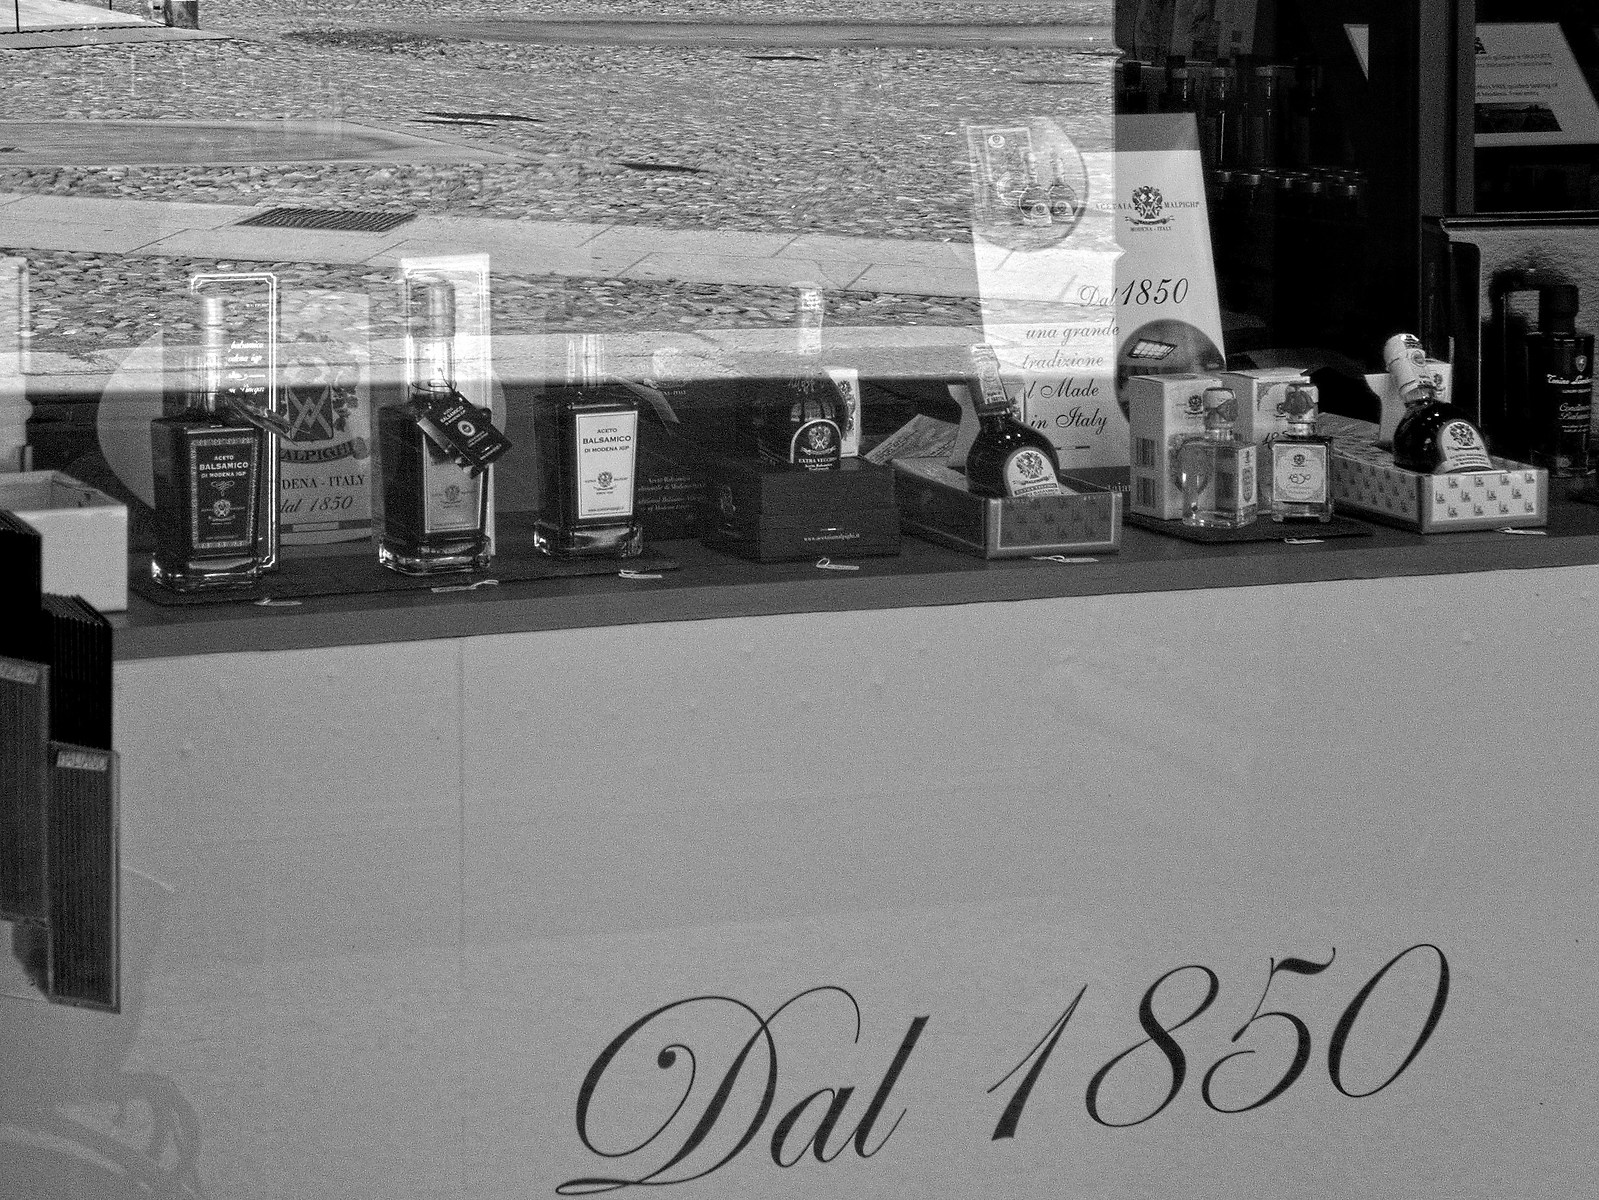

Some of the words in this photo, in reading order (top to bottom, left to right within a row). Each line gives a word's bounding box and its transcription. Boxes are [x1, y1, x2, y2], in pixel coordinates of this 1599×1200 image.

[1164, 200, 1200, 208] MALPIGHI
[1077, 285, 1118, 307] Dal
[1120, 278, 1190, 306] 1850
[1026, 327, 1059, 339] una
[1063, 318, 1120, 346] grande
[1022, 349, 1104, 369] tradizione
[1040, 376, 1100, 398] Made
[1030, 413, 1048, 430] in
[1055, 406, 1108, 435] Italy
[582, 435, 632, 445] BALSAMICO
[213, 454, 235, 462] ACETO
[281, 441, 355, 461] ALPIGHI
[199, 461, 249, 471] BALSAMICO
[209, 471, 235, 479] MODENA
[281, 477, 318, 490] DENA
[329, 474, 365, 487] ITALY
[309, 495, 354, 511] 1850
[555, 985, 930, 1197] Dal
[986, 942, 1451, 1142] 1850
